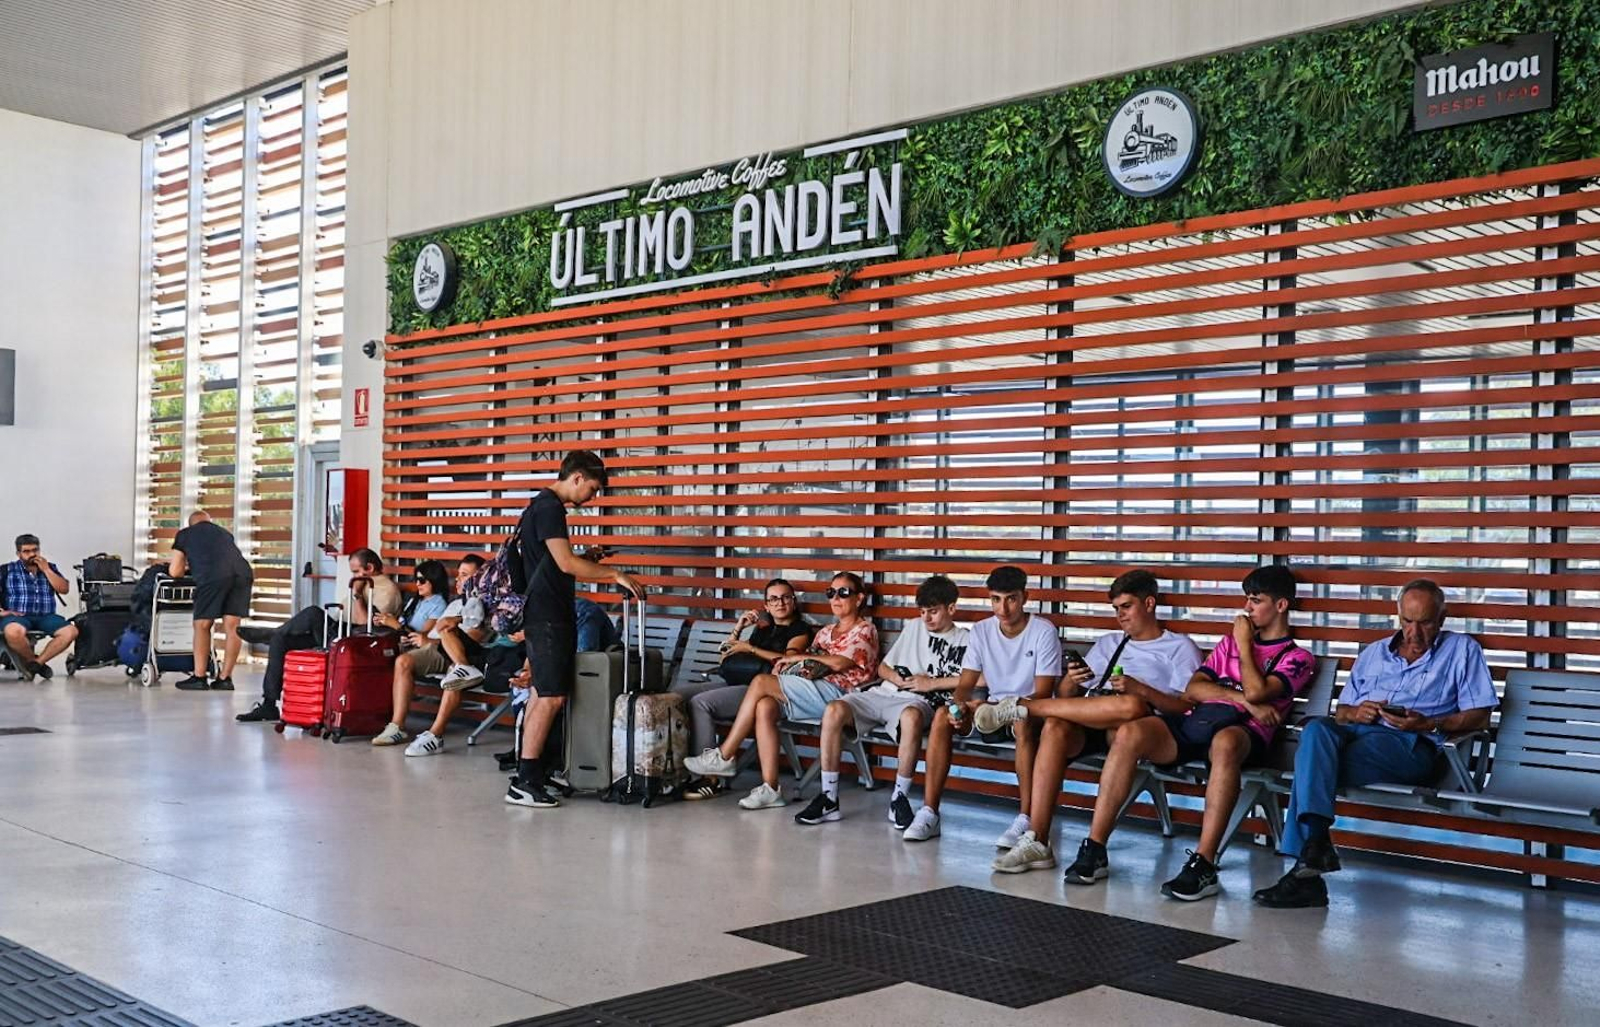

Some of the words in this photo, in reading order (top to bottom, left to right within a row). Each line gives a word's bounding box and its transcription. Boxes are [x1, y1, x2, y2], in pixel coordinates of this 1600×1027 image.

[1425, 55, 1541, 97] Mahou
[1427, 95, 1487, 118] DESDE
[640, 168, 730, 205] Locomotive
[731, 151, 788, 191] Coffee
[551, 212, 695, 290] ÚLTIMO
[731, 151, 901, 263] ANDÉN
